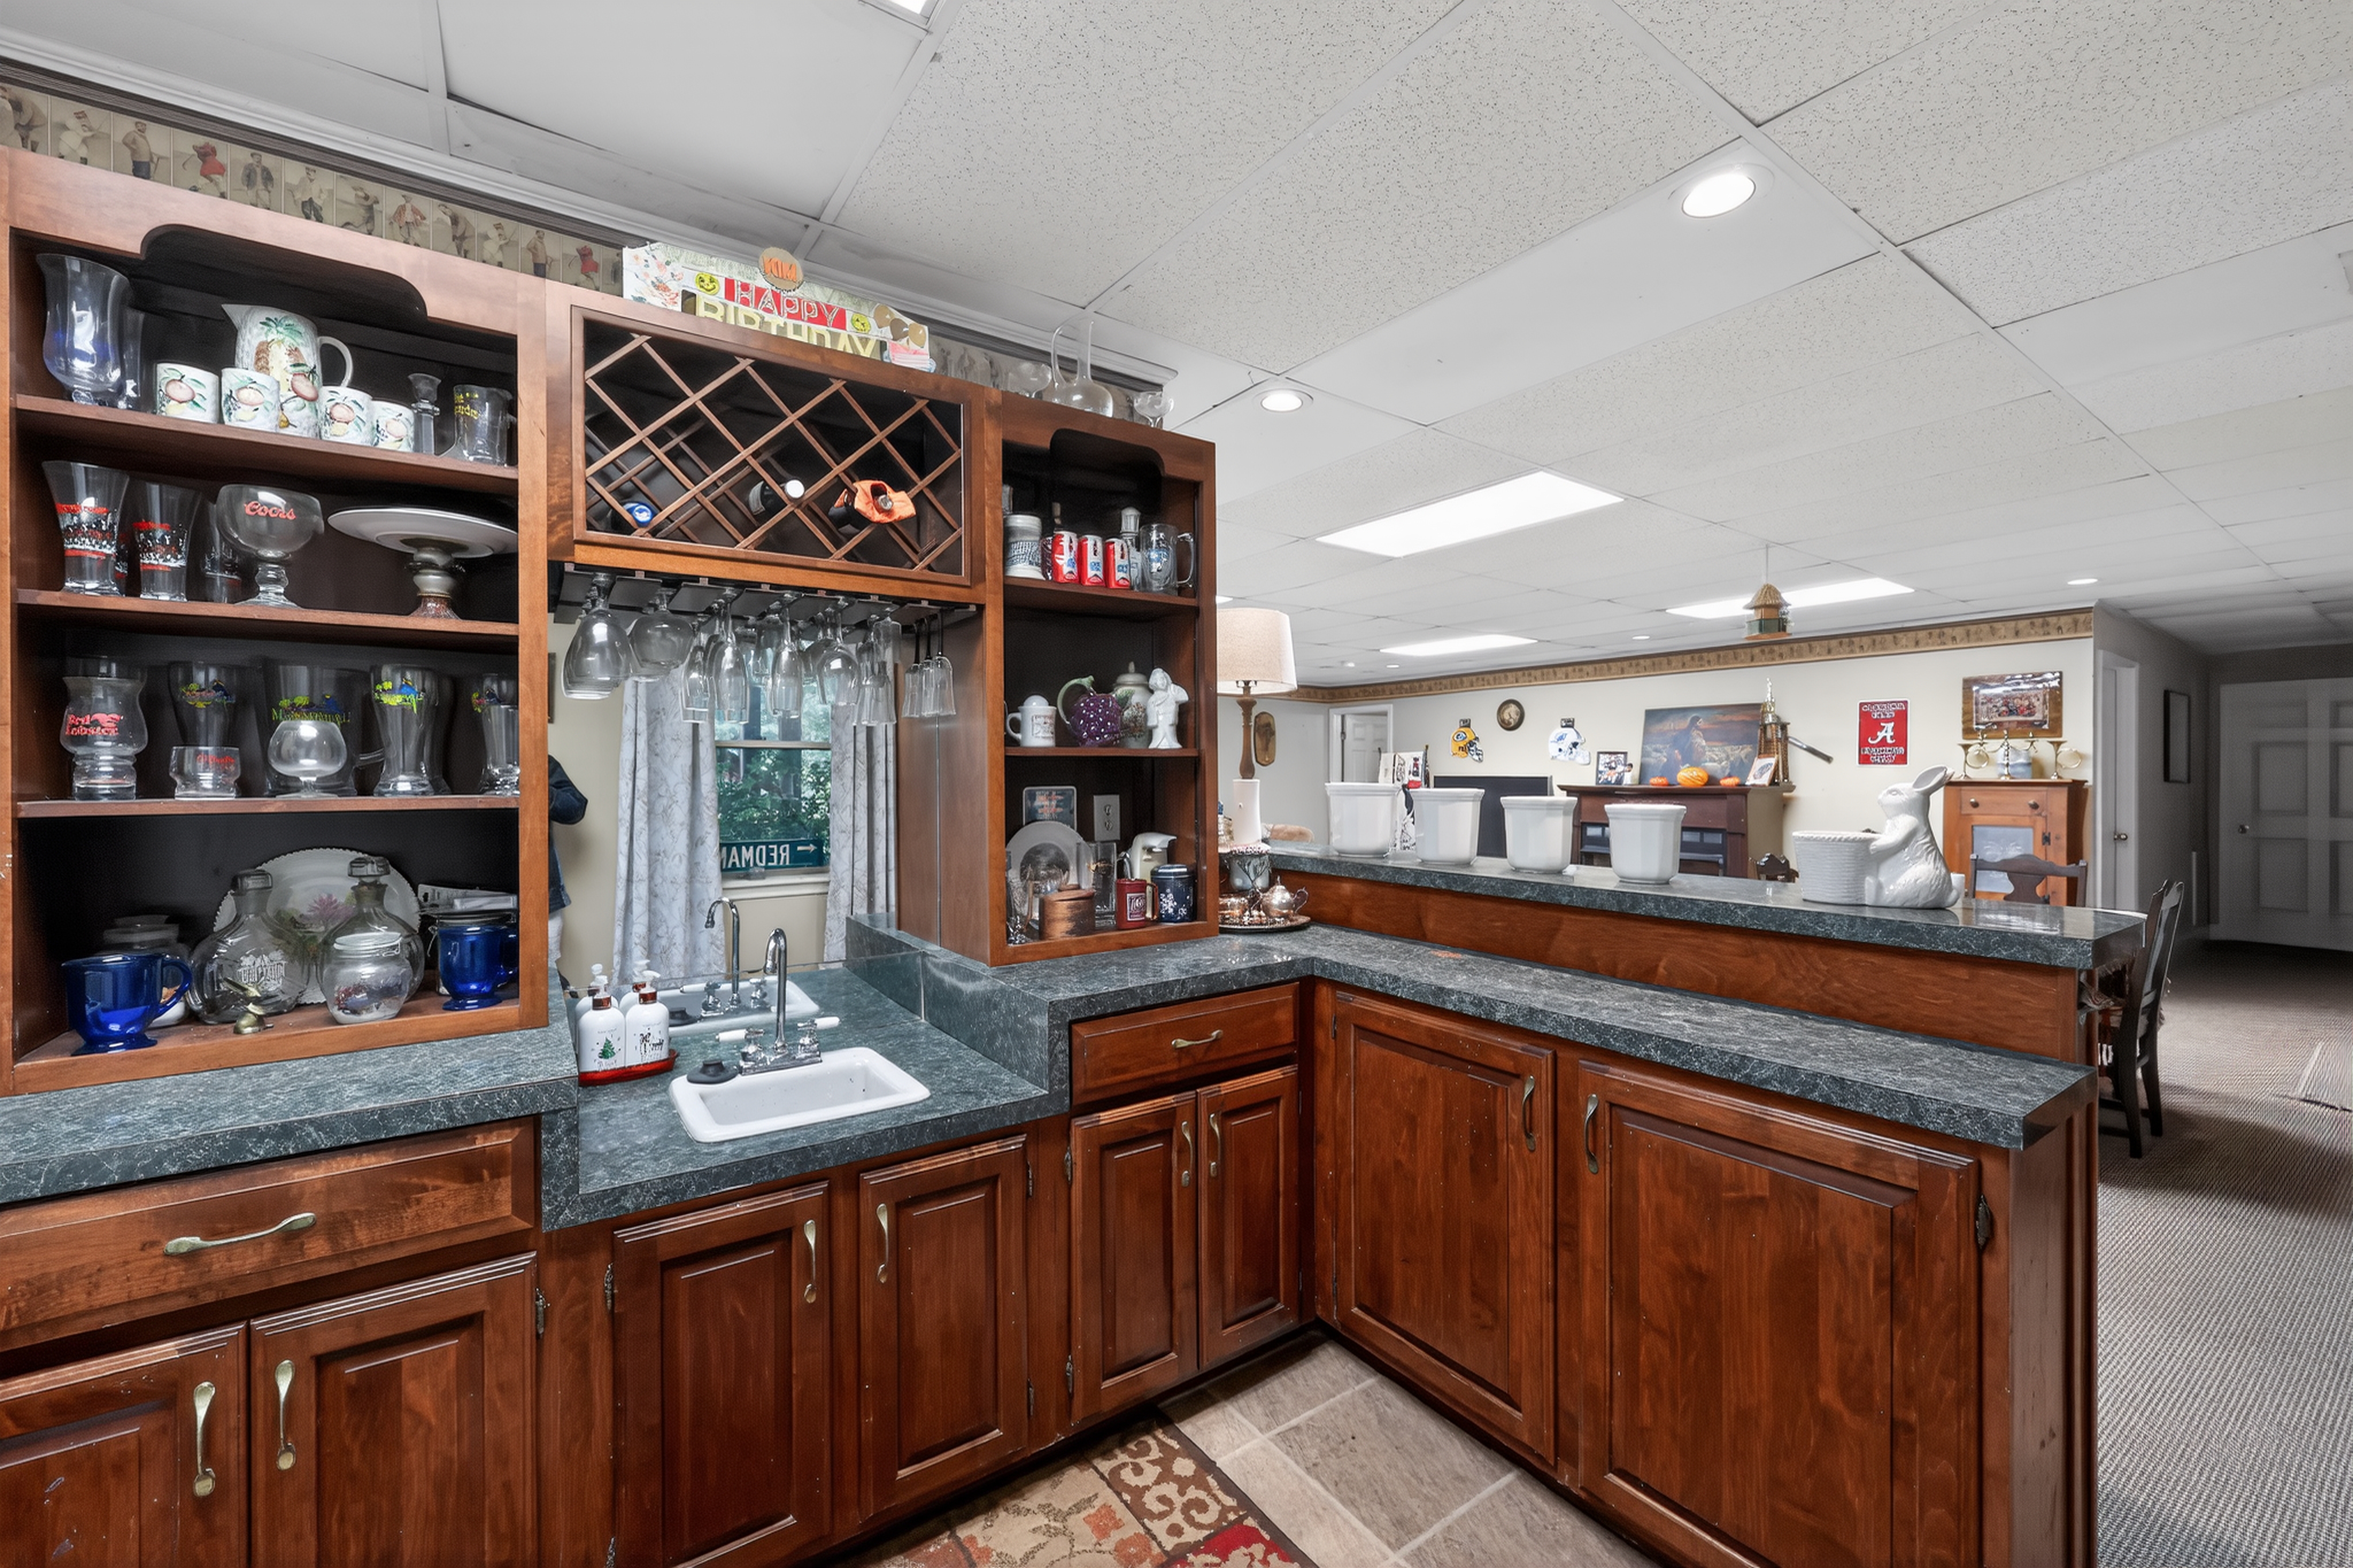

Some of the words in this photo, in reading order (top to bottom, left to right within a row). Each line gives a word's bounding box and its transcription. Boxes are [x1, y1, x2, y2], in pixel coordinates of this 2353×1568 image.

[762, 256, 797, 283] KIM
[736, 280, 839, 327] HAPPY
[244, 500, 297, 520] Coors
[1868, 721, 1896, 744] A
